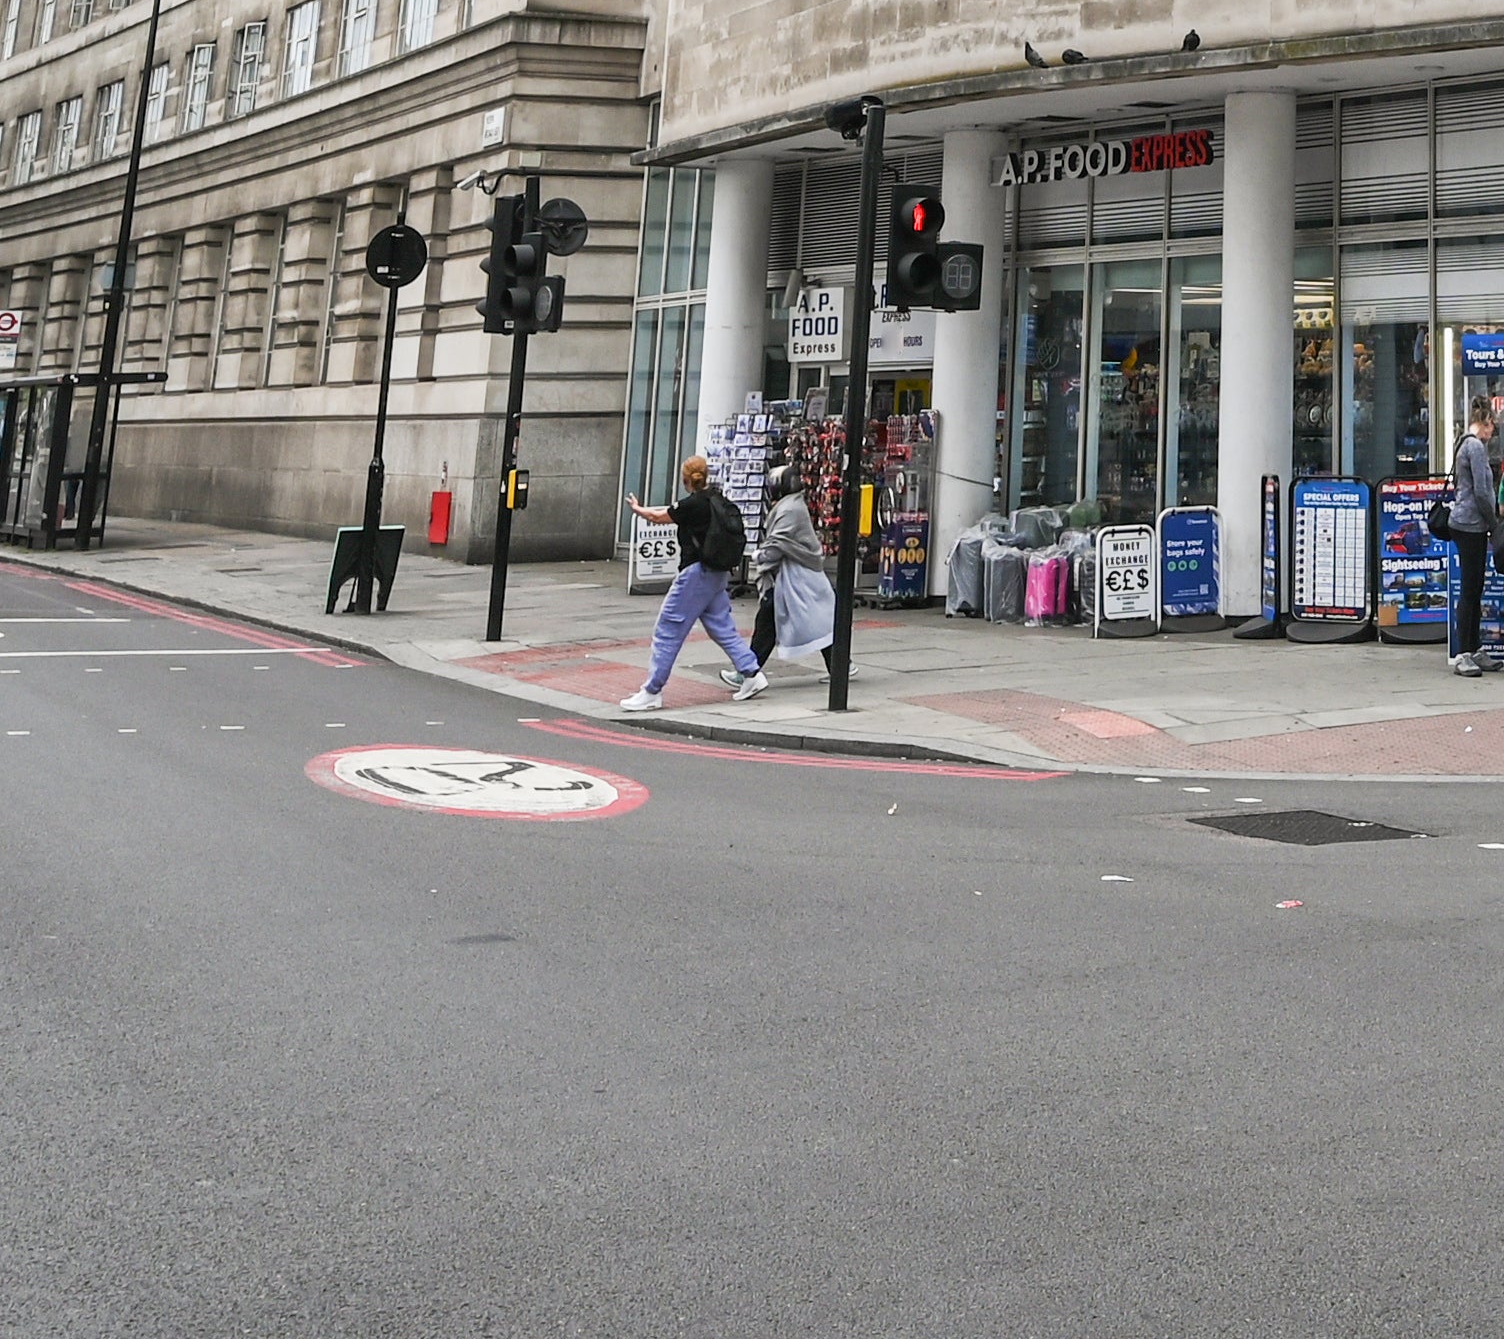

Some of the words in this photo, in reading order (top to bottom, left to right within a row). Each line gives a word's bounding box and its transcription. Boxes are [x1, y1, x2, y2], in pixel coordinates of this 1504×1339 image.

[999, 149, 1042, 186] A.P.
[1049, 140, 1127, 181] FOOD
[1130, 129, 1209, 172] EXPRESS
[797, 292, 834, 314] A.P.
[791, 316, 839, 337] FOOD
[903, 335, 923, 347] HOURS
[793, 342, 836, 355] Express
[1465, 349, 1495, 360] Tours
[1496, 348, 1504, 359] &
[1382, 484, 1397, 493] Buy
[1302, 493, 1331, 502] SPECIAL
[1332, 492, 1360, 502] OFFERS
[1383, 501, 1423, 514] Hop-on
[1394, 513, 1412, 521] Open
[1113, 542, 1141, 552] MONEY
[1187, 539, 1204, 548] your
[1166, 549, 1184, 558] bags
[1185, 547, 1205, 557] safely
[1105, 555, 1149, 567] EXCHANGE
[1381, 558, 1441, 573] Sightseeing
